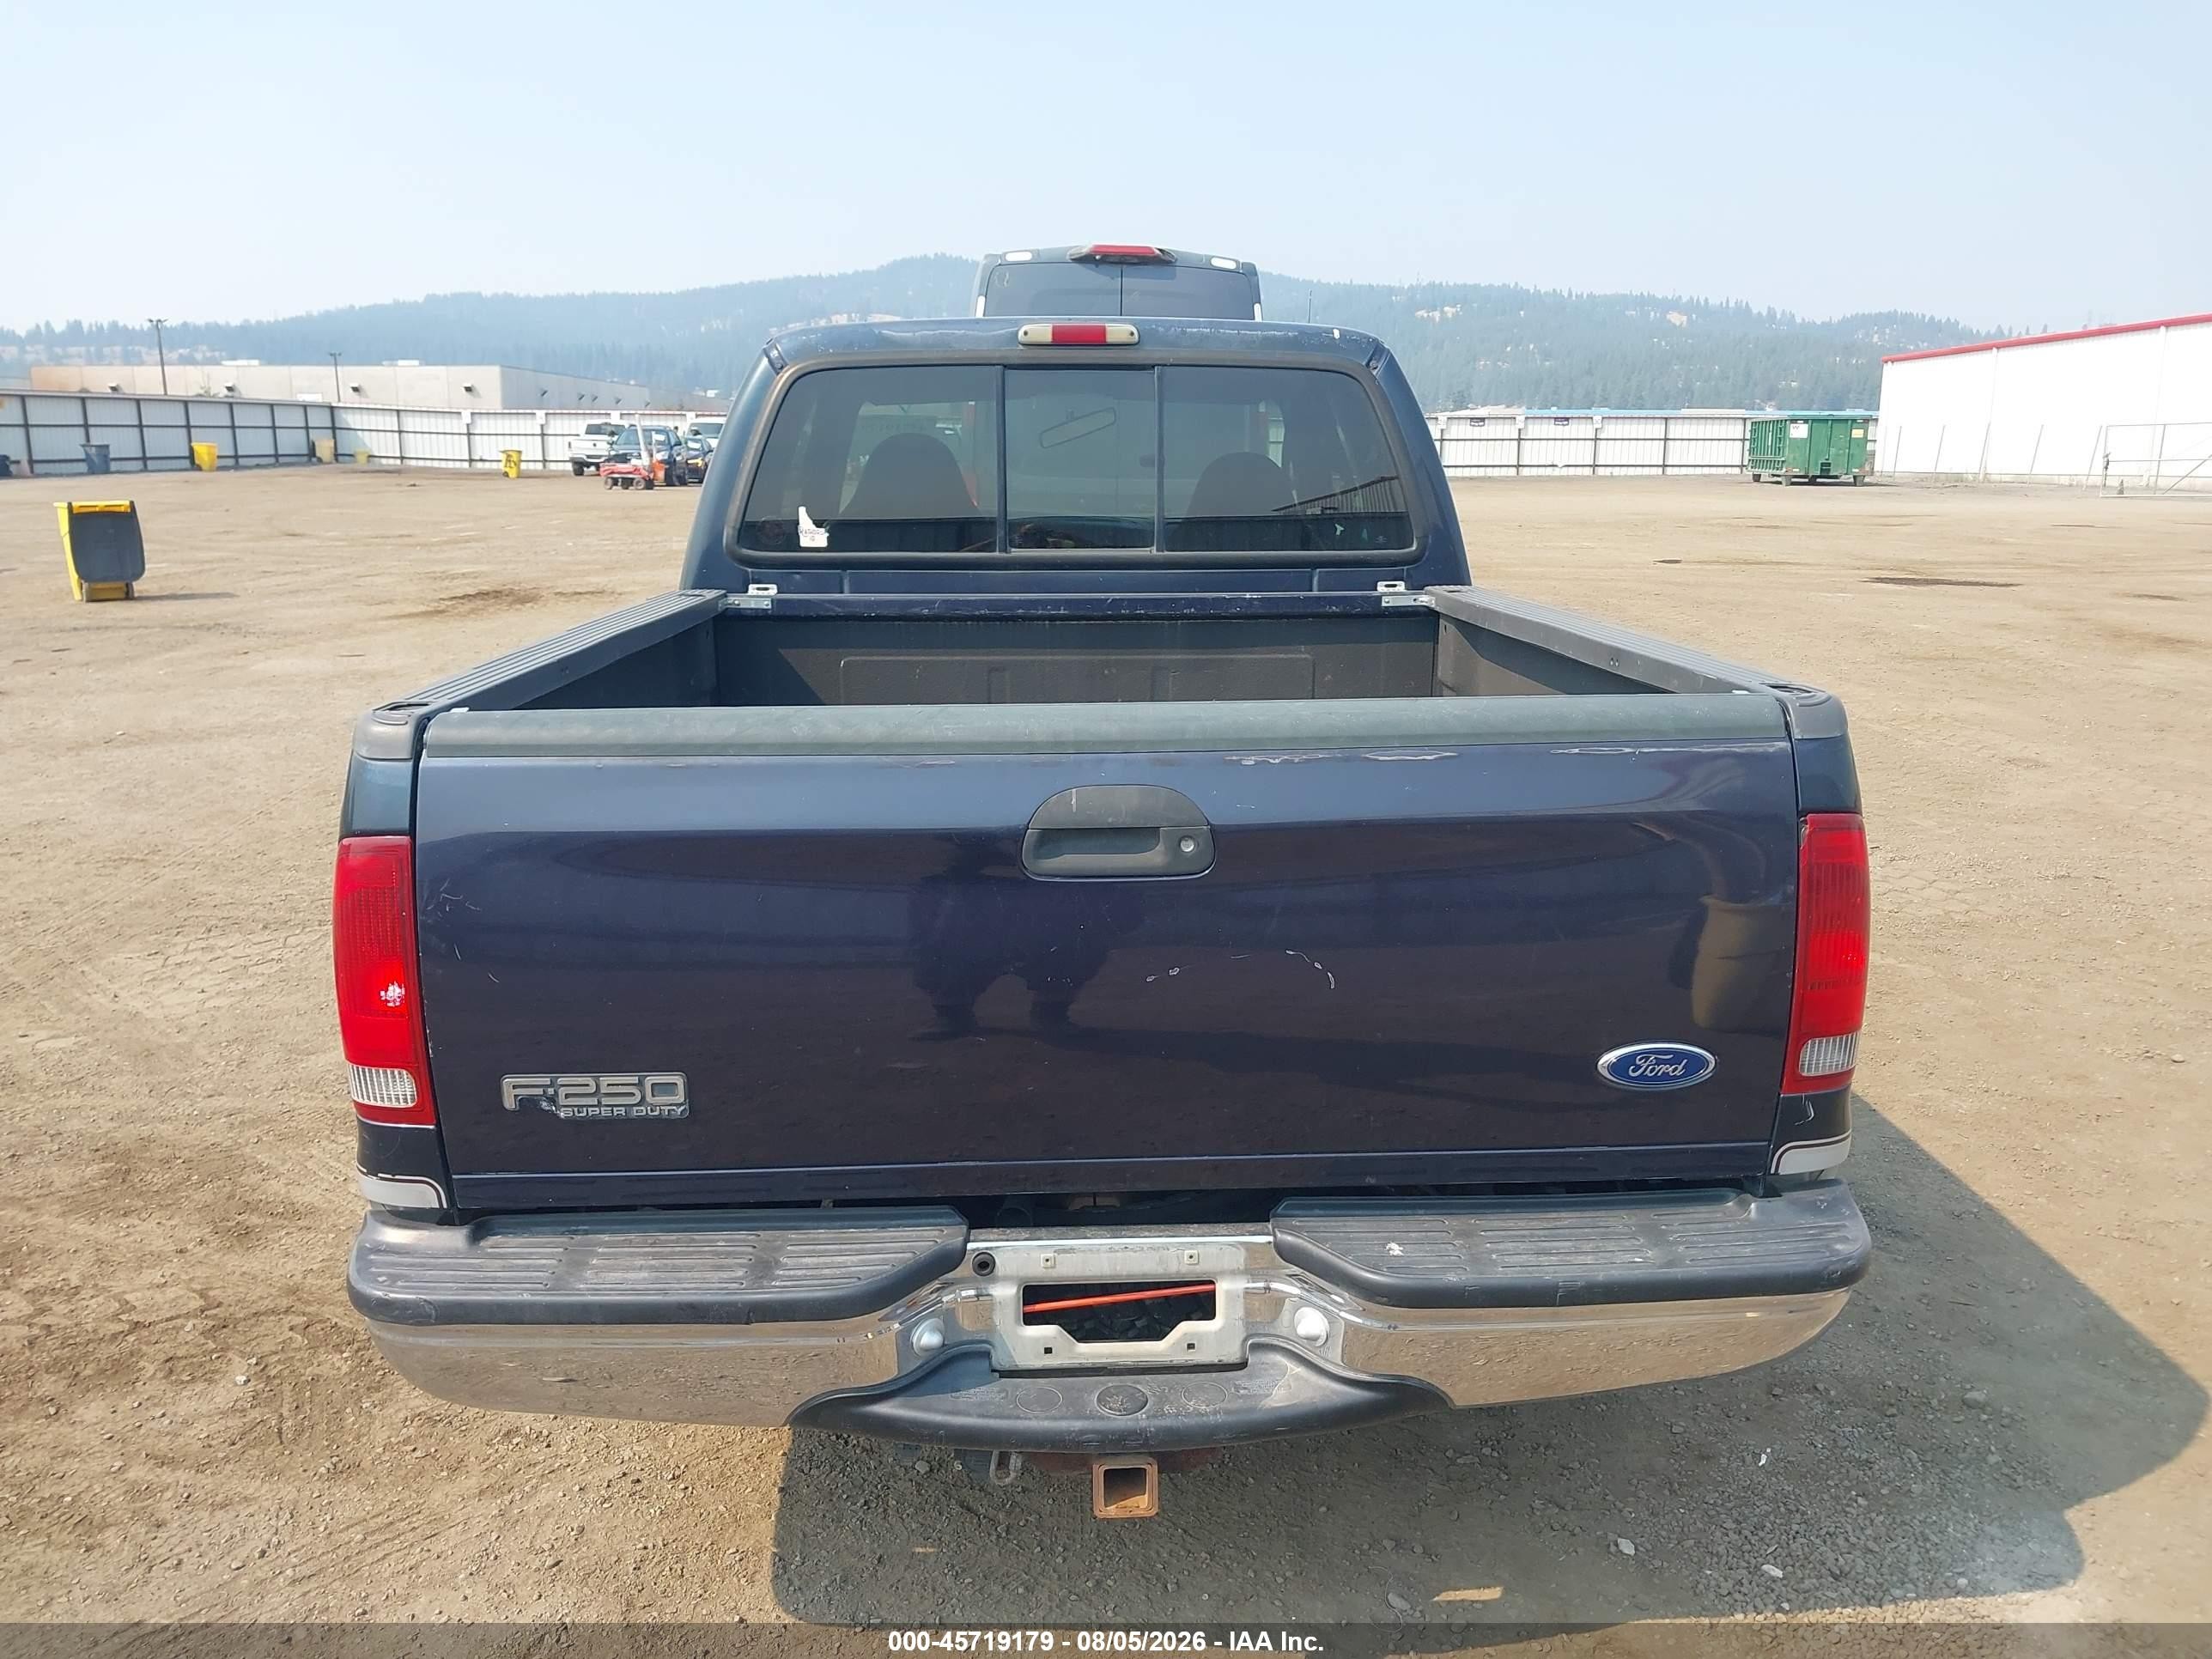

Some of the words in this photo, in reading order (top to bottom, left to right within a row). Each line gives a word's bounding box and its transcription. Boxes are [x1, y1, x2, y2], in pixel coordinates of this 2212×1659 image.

[1629, 1054, 1687, 1077] Ford
[503, 1076, 686, 1109] F-250
[560, 1106, 626, 1117] SUPER
[633, 1105, 687, 1116] DUTY
